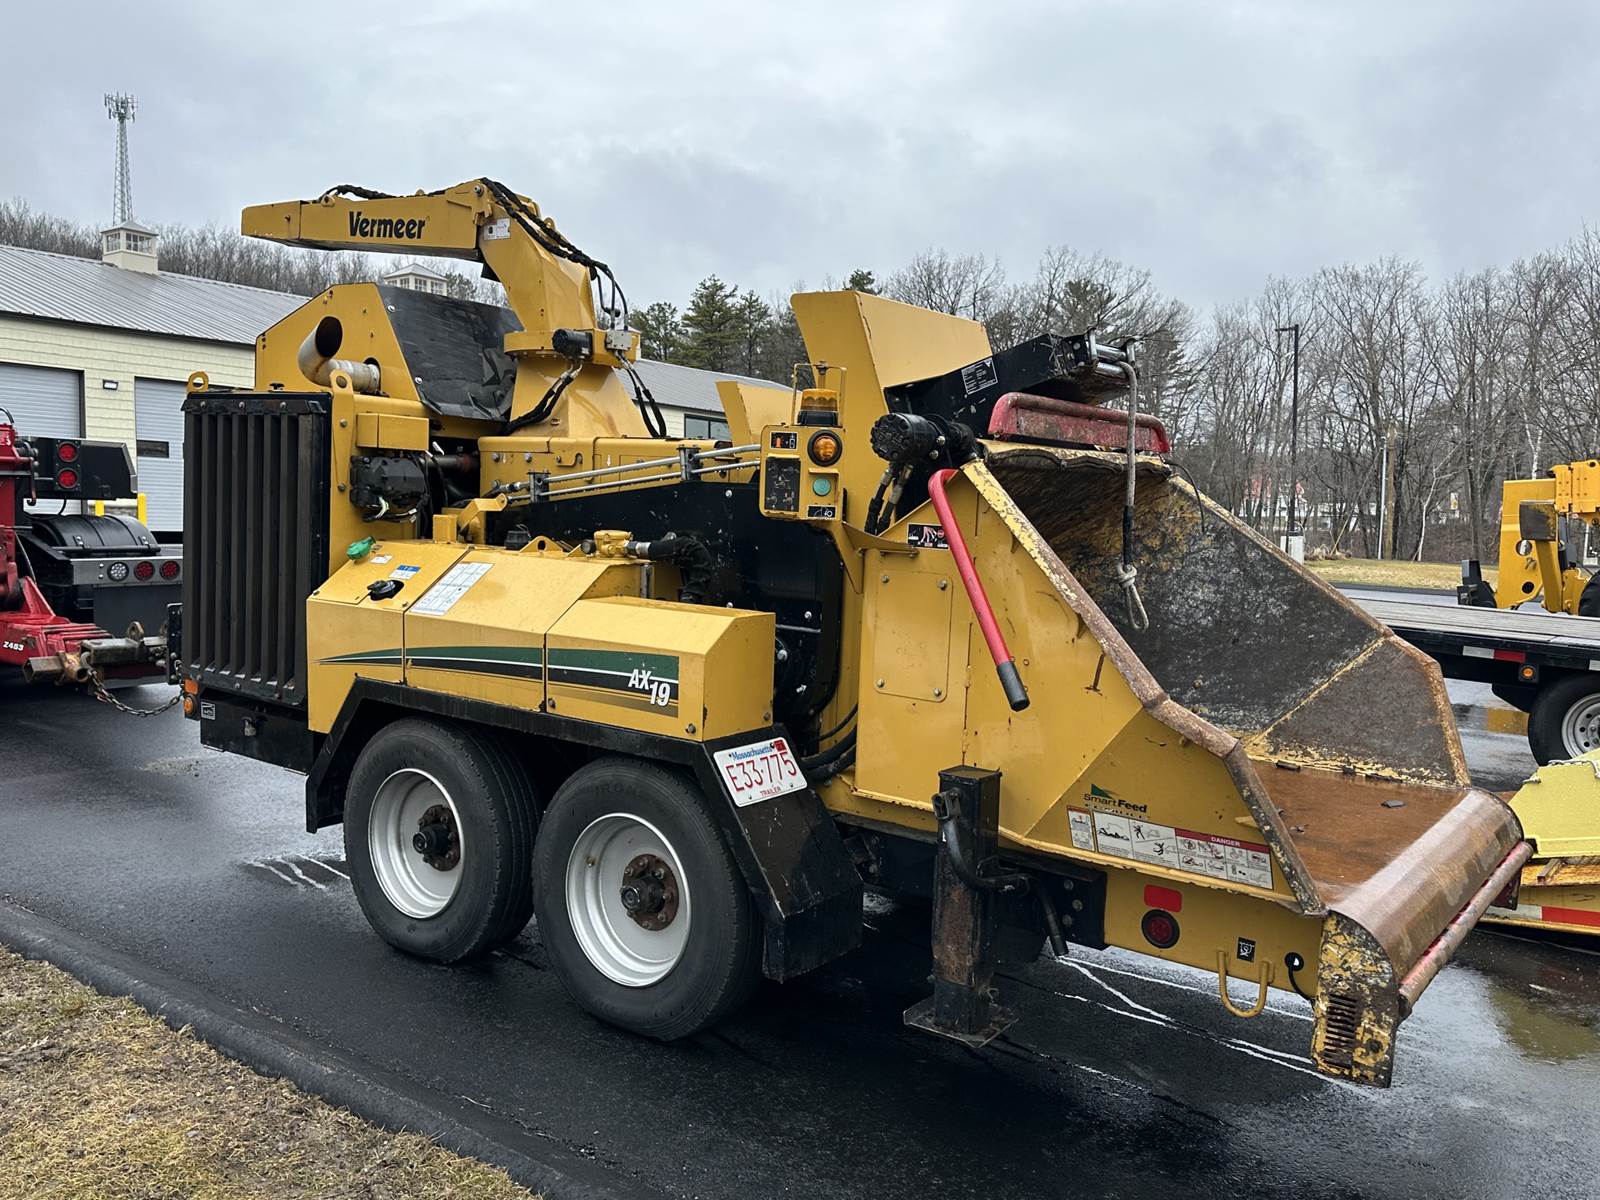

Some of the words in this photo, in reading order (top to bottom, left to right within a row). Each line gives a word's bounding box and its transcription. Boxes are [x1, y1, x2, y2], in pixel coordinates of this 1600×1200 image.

[349, 211, 426, 239] Vermeer
[628, 668, 652, 690] AX
[649, 681, 671, 706] 19
[731, 746, 773, 760] Massachusetts
[760, 785, 782, 797] TRAILER
[1210, 836, 1241, 847] DANGER
